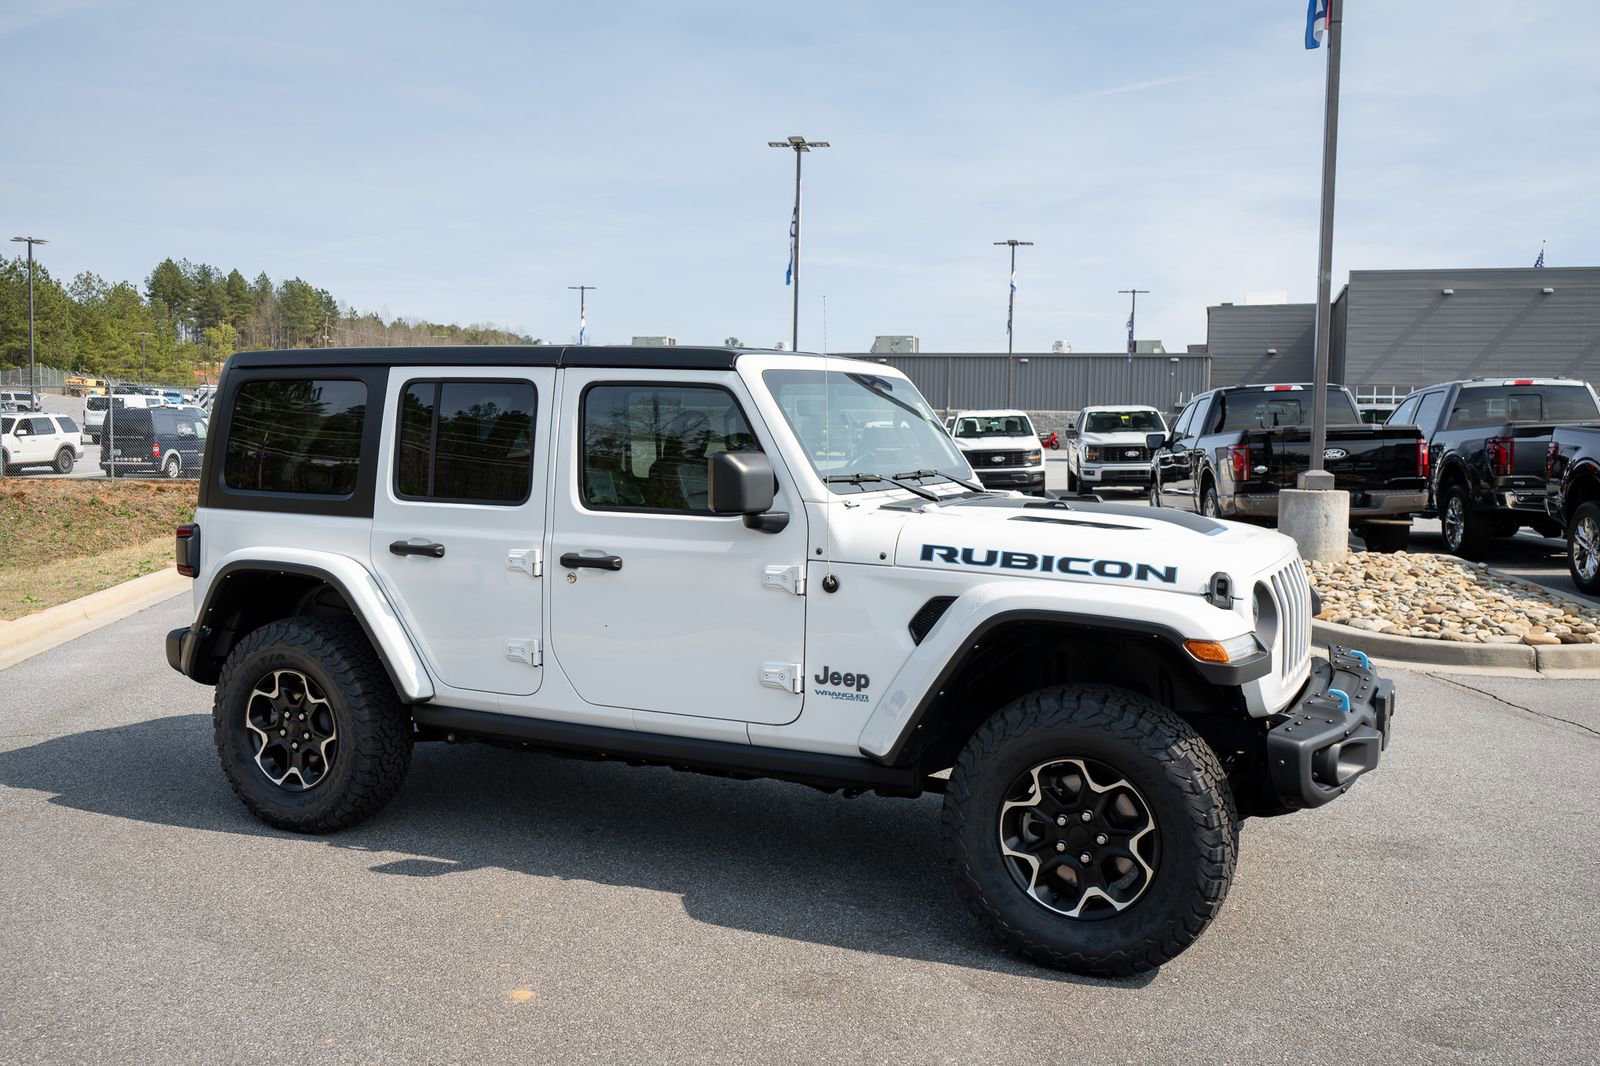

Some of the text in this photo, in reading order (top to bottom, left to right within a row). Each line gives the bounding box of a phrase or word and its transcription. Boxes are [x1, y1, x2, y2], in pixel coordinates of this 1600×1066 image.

[920, 543, 1178, 584] RUBICON
[814, 666, 870, 692] Jeep
[814, 689, 869, 700] WRANGLER
